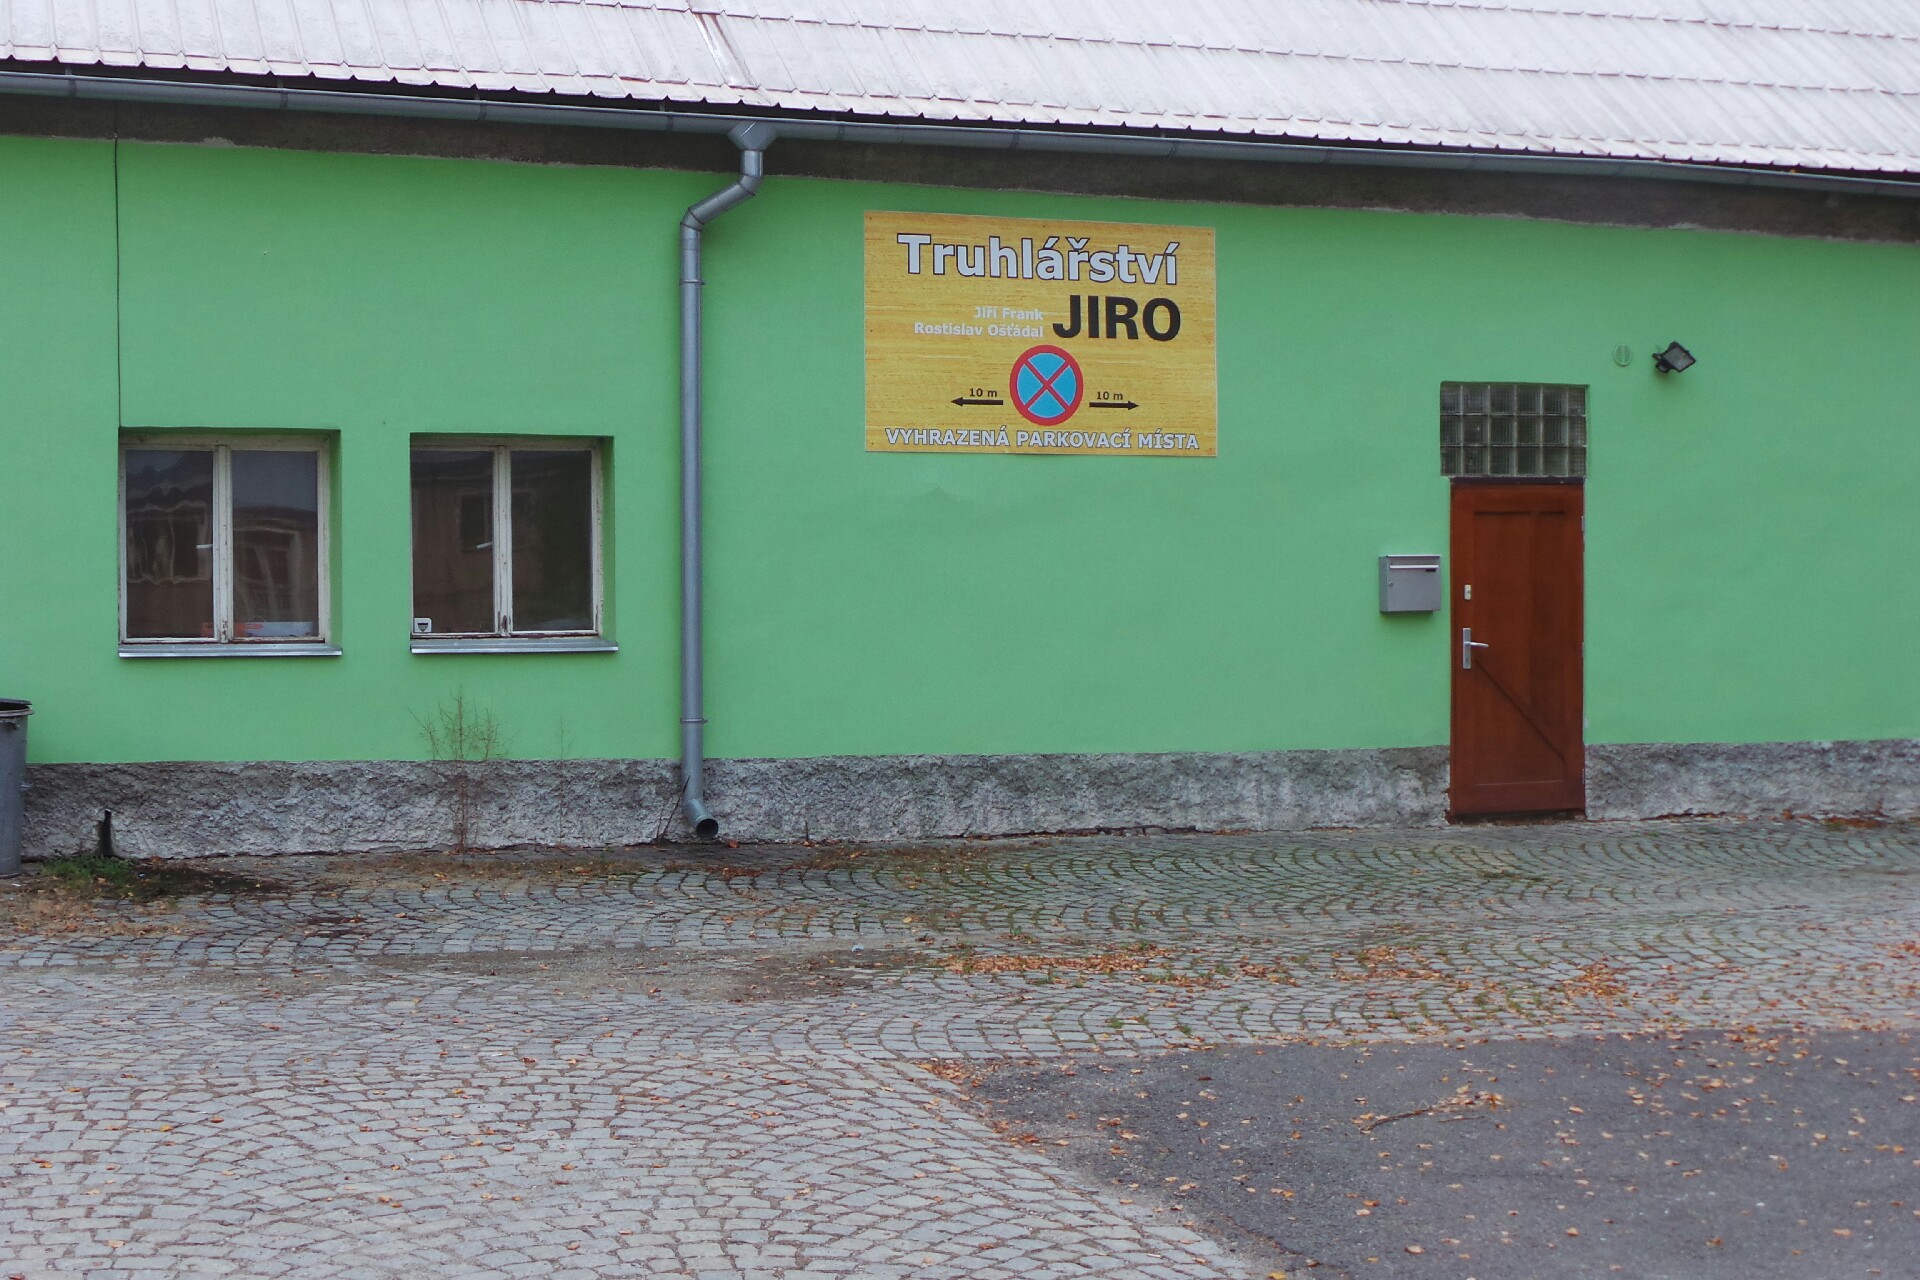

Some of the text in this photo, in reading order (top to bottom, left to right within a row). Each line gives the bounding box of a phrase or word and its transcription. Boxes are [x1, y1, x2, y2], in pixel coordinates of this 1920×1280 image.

[897, 233, 1180, 285] Truhlářství
[1002, 308, 1044, 321] Frank
[1053, 295, 1181, 341] JIRO
[914, 322, 983, 336] Rostislav
[969, 388, 984, 397] 10
[1096, 391, 1110, 400] 10
[885, 425, 1199, 449] VYHRAZENÁ PARKOVACÍ MÍSTA
